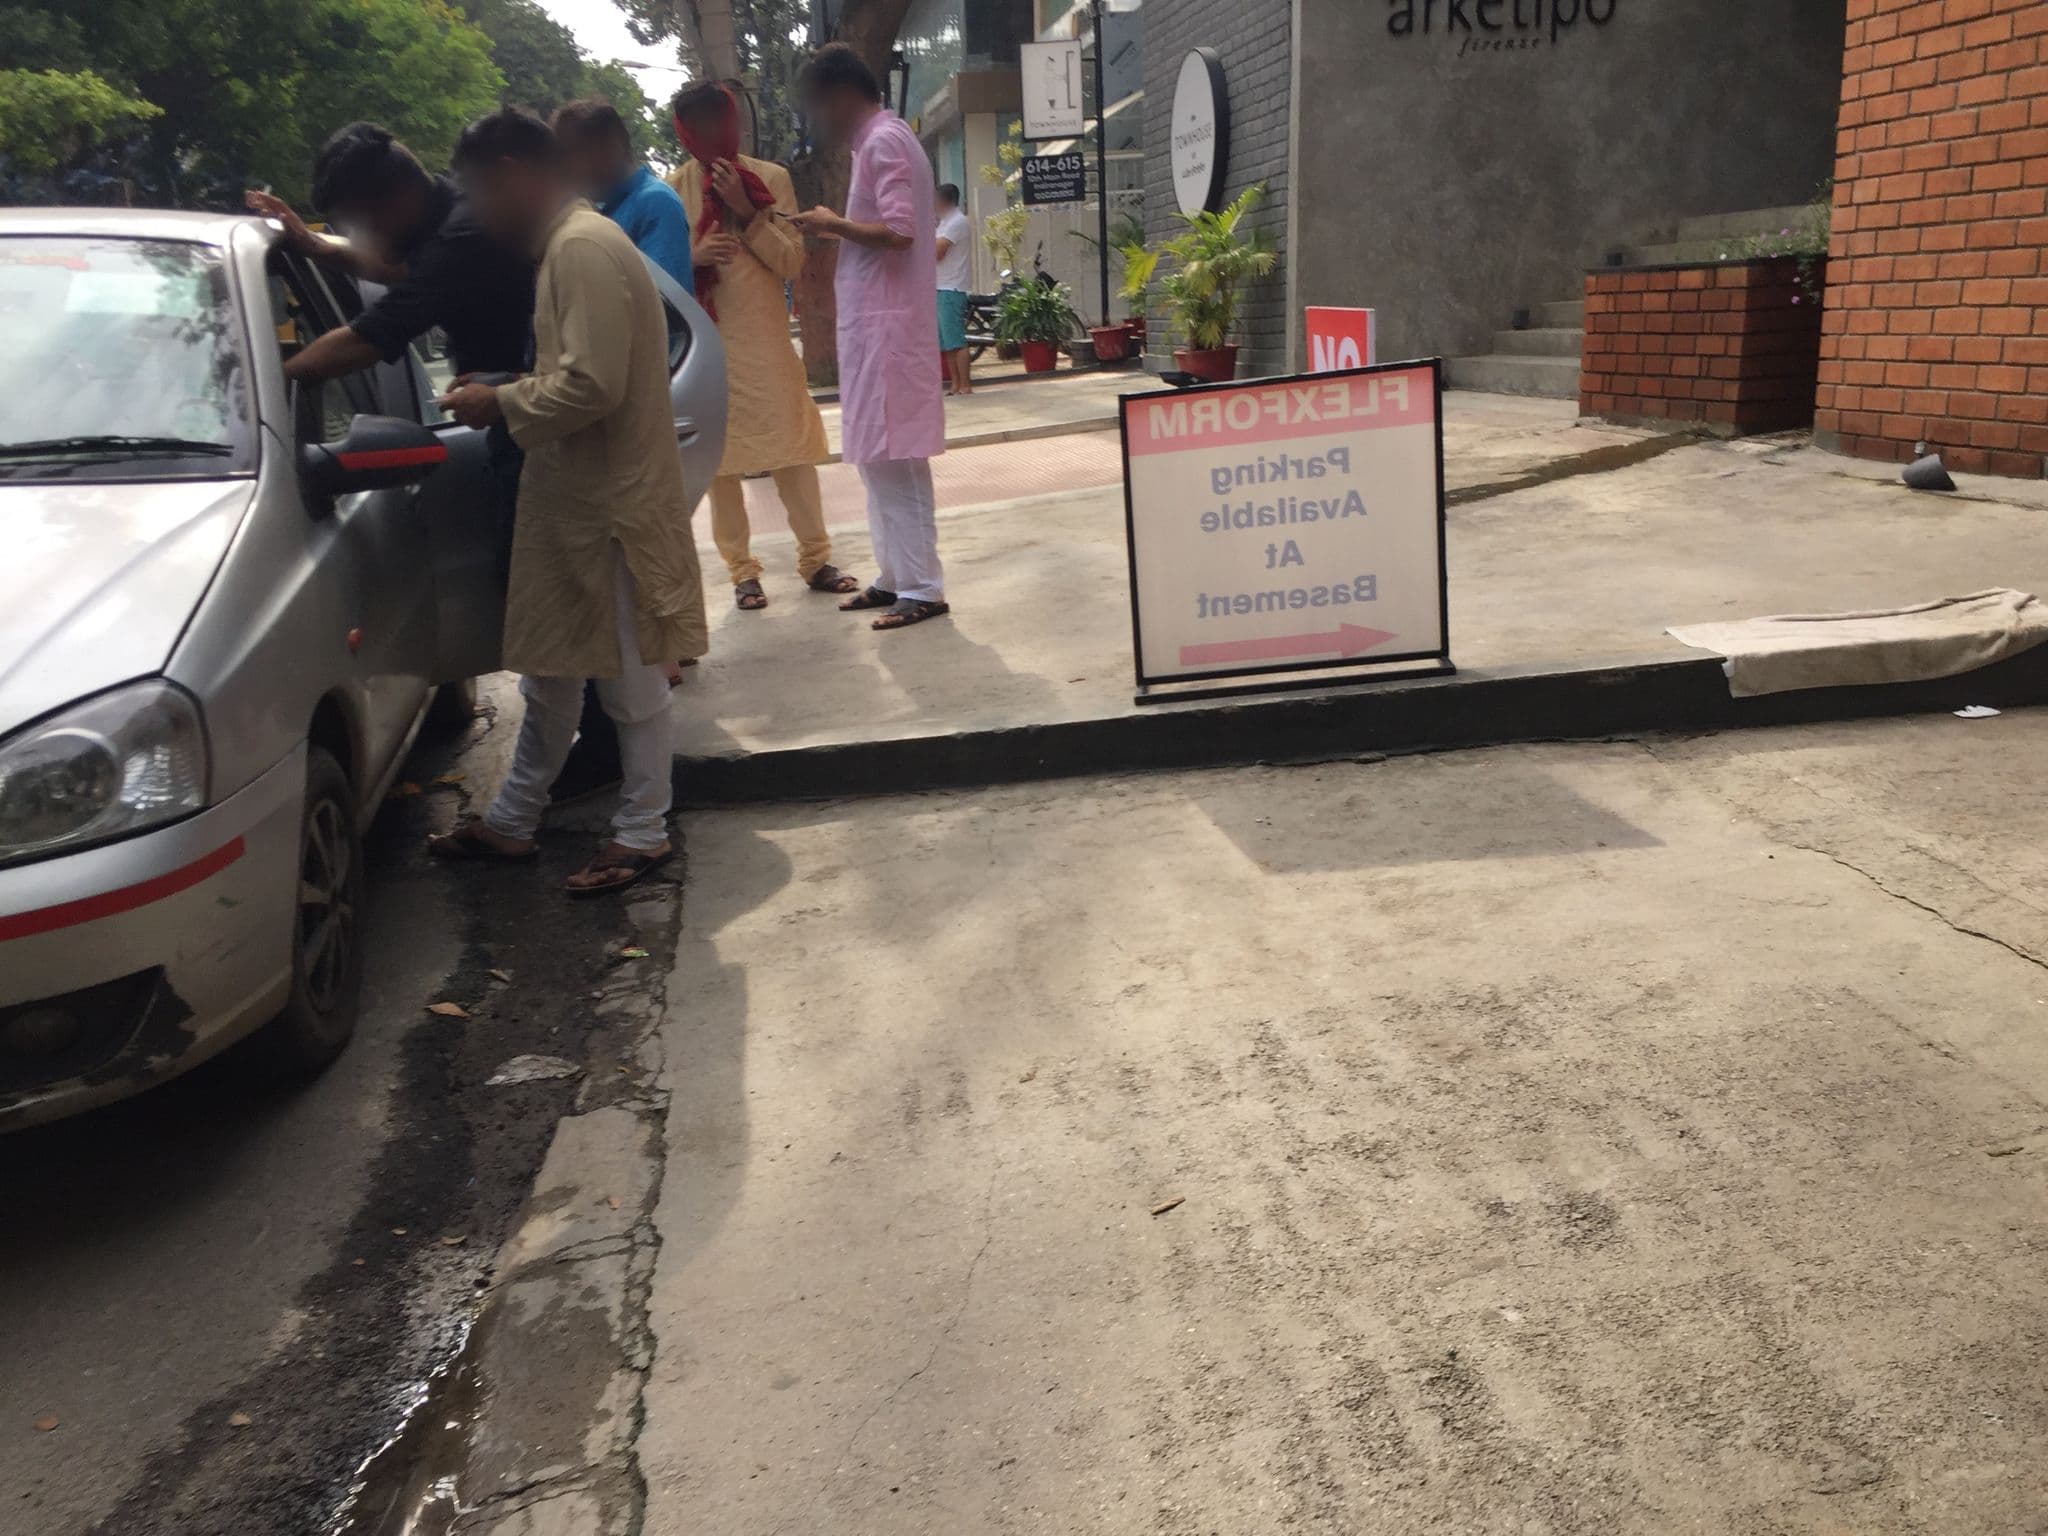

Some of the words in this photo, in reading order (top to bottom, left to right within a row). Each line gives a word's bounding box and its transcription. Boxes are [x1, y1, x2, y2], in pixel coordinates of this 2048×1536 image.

[1456, 37, 1541, 58] firenze
[1025, 156, 1081, 174] 614-615
[1313, 334, 1361, 372] NO
